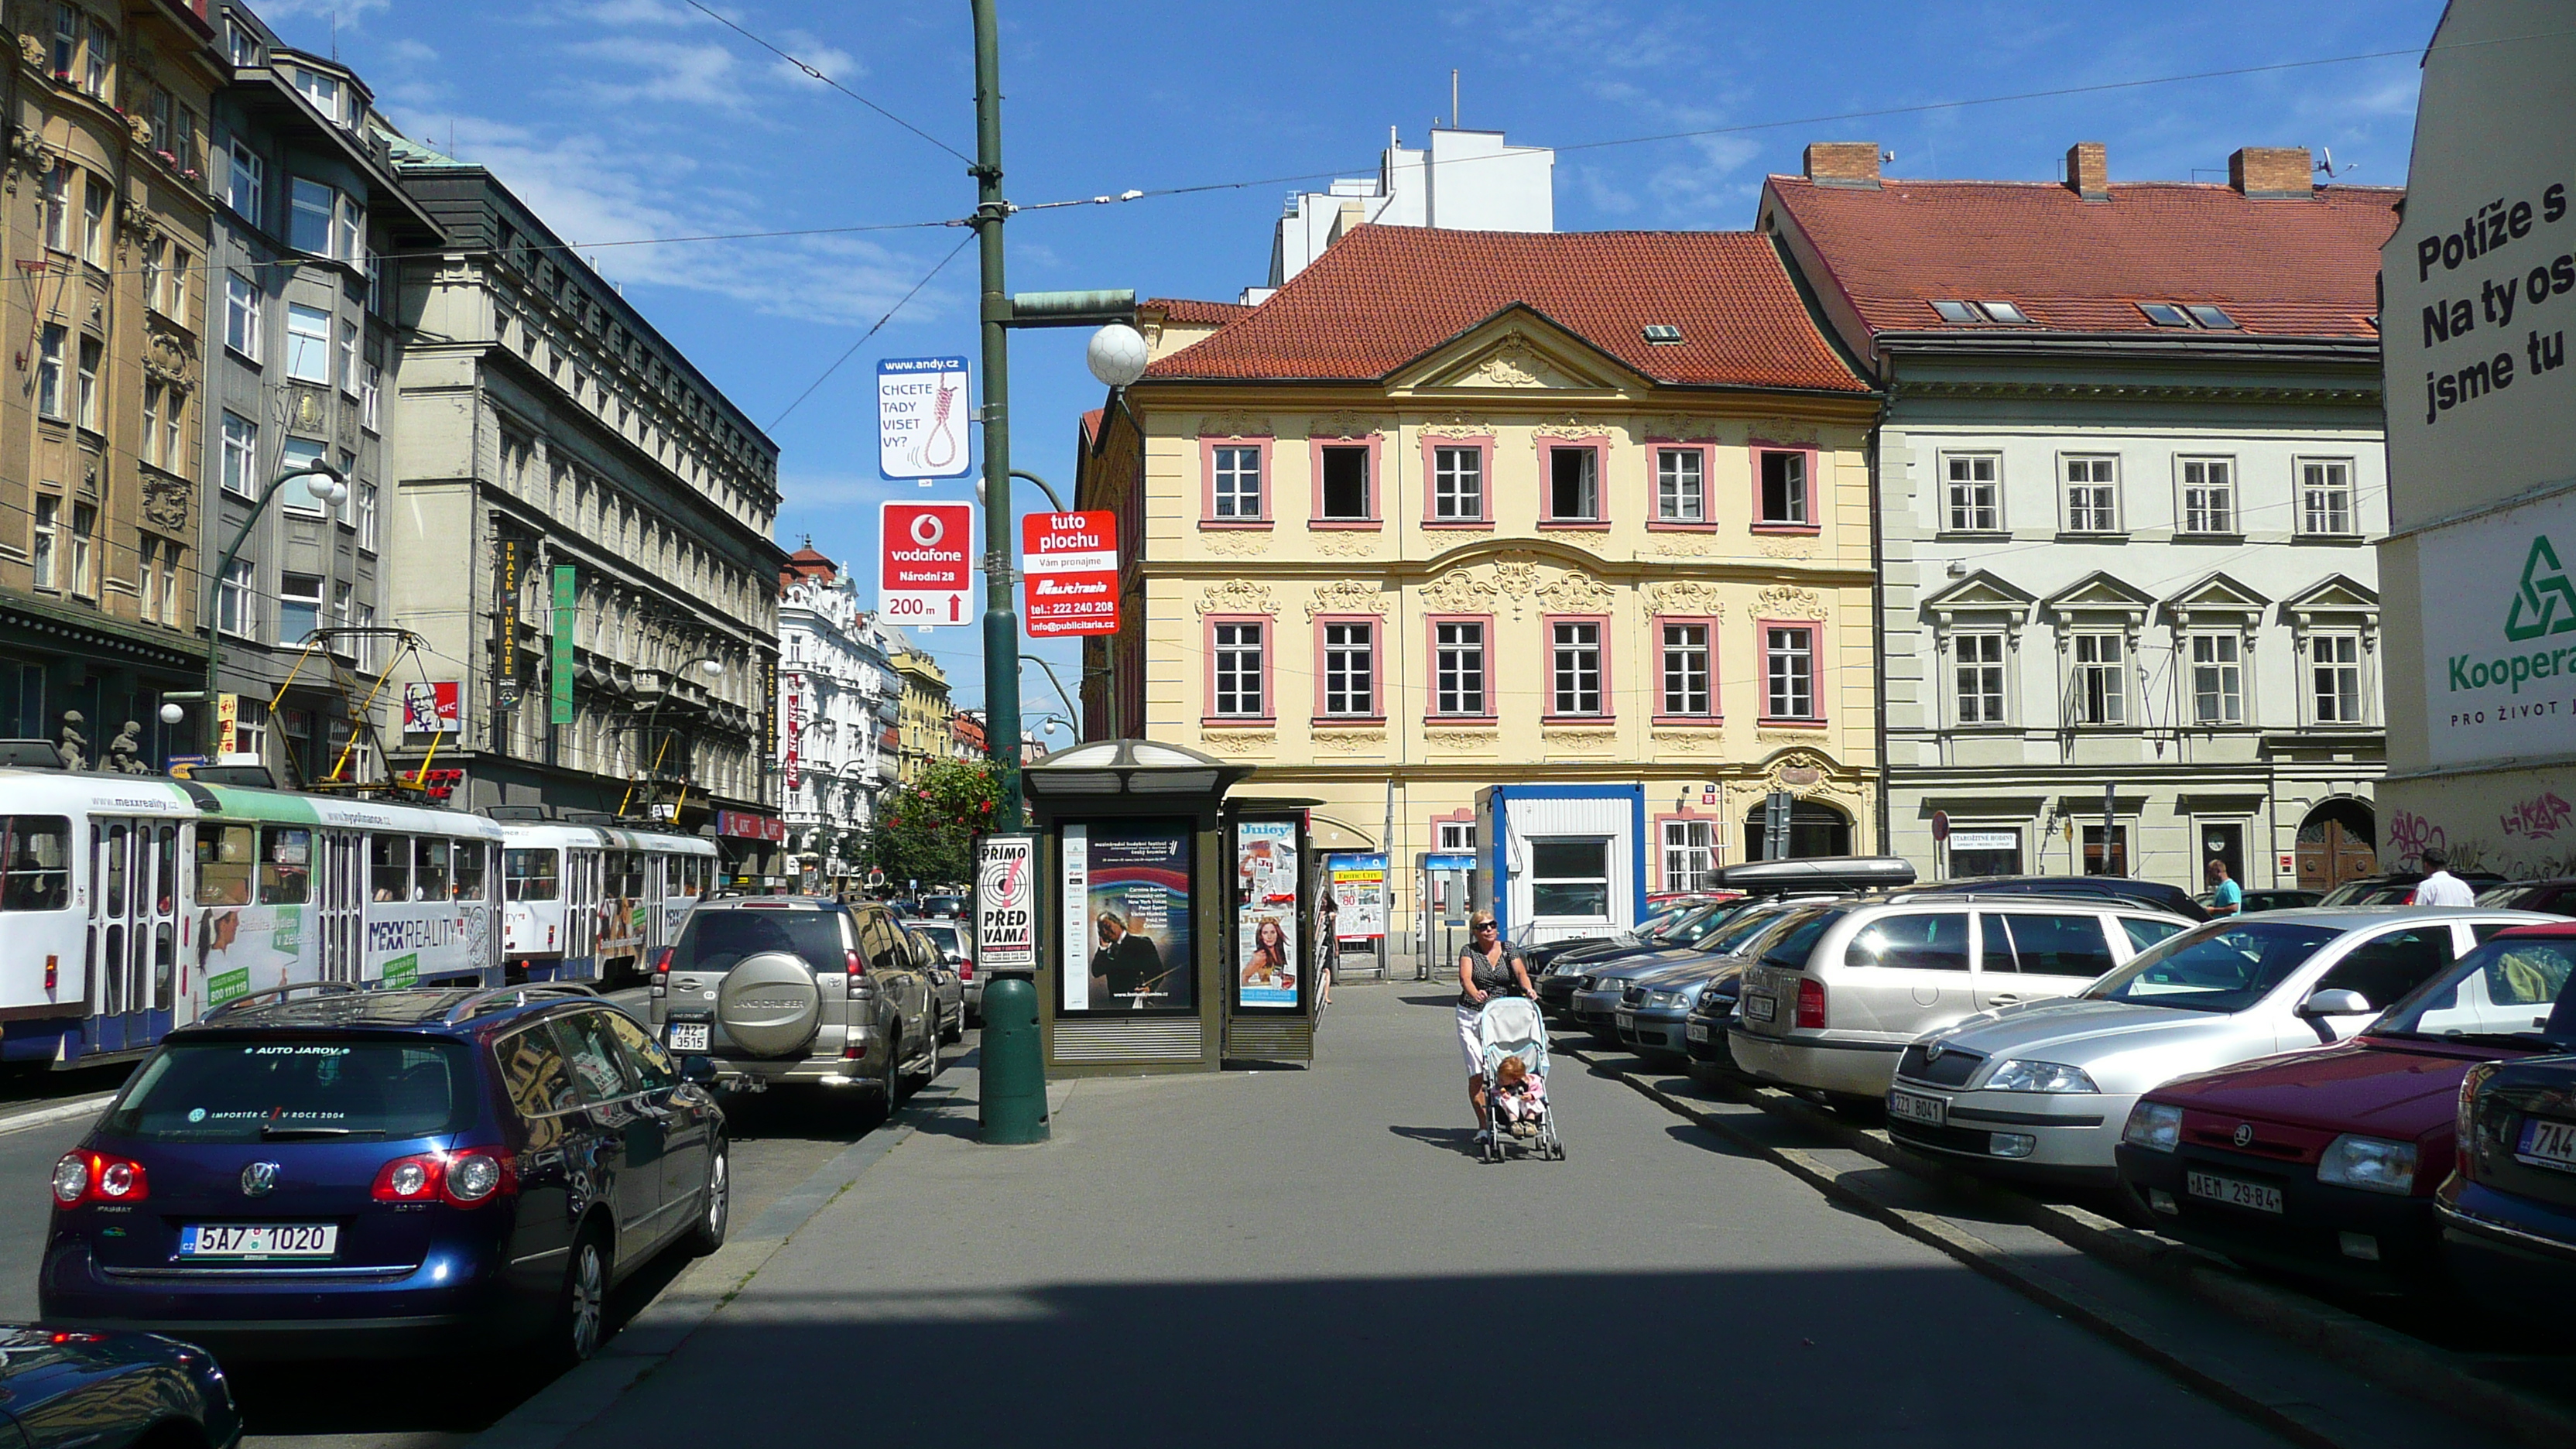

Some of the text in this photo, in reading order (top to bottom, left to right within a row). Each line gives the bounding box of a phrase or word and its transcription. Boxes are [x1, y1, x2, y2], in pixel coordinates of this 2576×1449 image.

[2417, 183, 2567, 283] Potíže s
[2422, 253, 2576, 349] Na ty os
[885, 358, 959, 371] www.andy.cz
[2426, 330, 2564, 425] jsme tu
[882, 383, 933, 396] CHCETE
[882, 401, 917, 413] TADY
[882, 419, 921, 430] VISET
[883, 436, 908, 448] VY?
[1050, 513, 1086, 530] tuto
[1040, 531, 1099, 553] plochu
[891, 547, 962, 562] vodafone
[505, 541, 516, 591] BLACK
[1039, 557, 1102, 568] Vám pronajme
[899, 570, 954, 581] Národní 28
[889, 598, 936, 615] 200 m
[1030, 601, 1114, 615] tel.: 222 240 208
[1031, 620, 1115, 632] info@publicitaria.cz
[504, 606, 515, 675] THEATRE
[438, 702, 456, 714] KFC
[789, 701, 797, 722] KFC
[2451, 711, 2485, 728] PRO
[2498, 701, 2558, 721] ŽIVOT
[789, 729, 797, 752] KFC
[789, 759, 797, 782] KFC
[91, 796, 180, 810] www.mexxreality.cz
[1241, 824, 1290, 838] Juicy
[981, 845, 1026, 862] PŘÍMO
[1343, 896, 1355, 906] 80
[984, 909, 1027, 927] PŘED
[211, 988, 224, 1002] 800
[733, 999, 805, 1009] LAND CRUISER
[677, 1024, 697, 1036] 7A2
[677, 1036, 704, 1048] 3515
[211, 1110, 258, 1118] IMPORTÉR
[1915, 1099, 1938, 1120] 8041
[2534, 1124, 2575, 1158] 7A4
[2196, 1174, 2222, 1198] AEM
[201, 1227, 325, 1250] 5A7 1020
[182, 1242, 195, 1251] CZ
